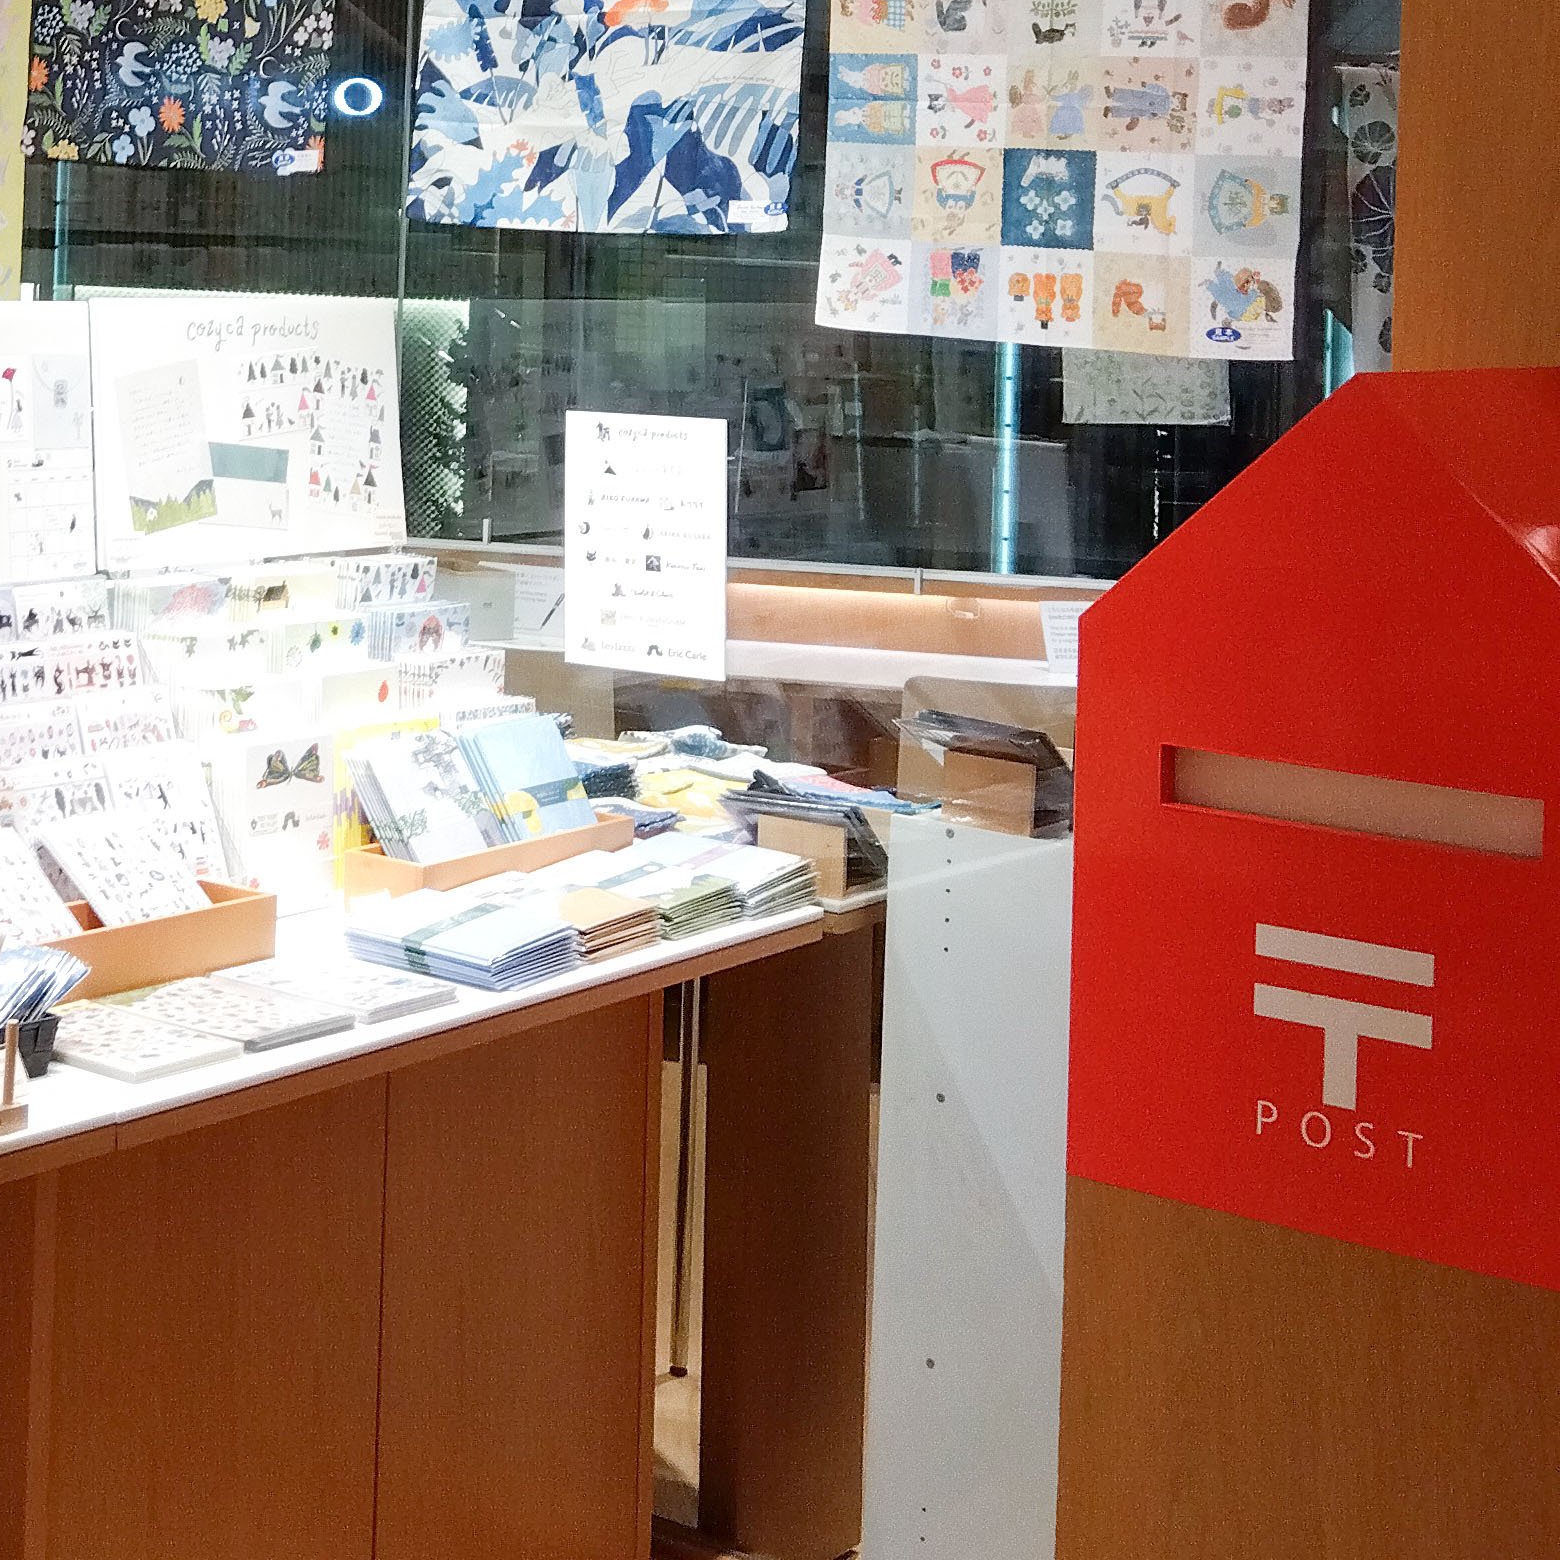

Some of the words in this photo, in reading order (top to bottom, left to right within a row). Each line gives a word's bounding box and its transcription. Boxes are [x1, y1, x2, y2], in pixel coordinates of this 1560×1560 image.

[187, 315, 244, 352] cozyca
[251, 316, 319, 345] products
[1255, 1099, 1424, 1168] POST
